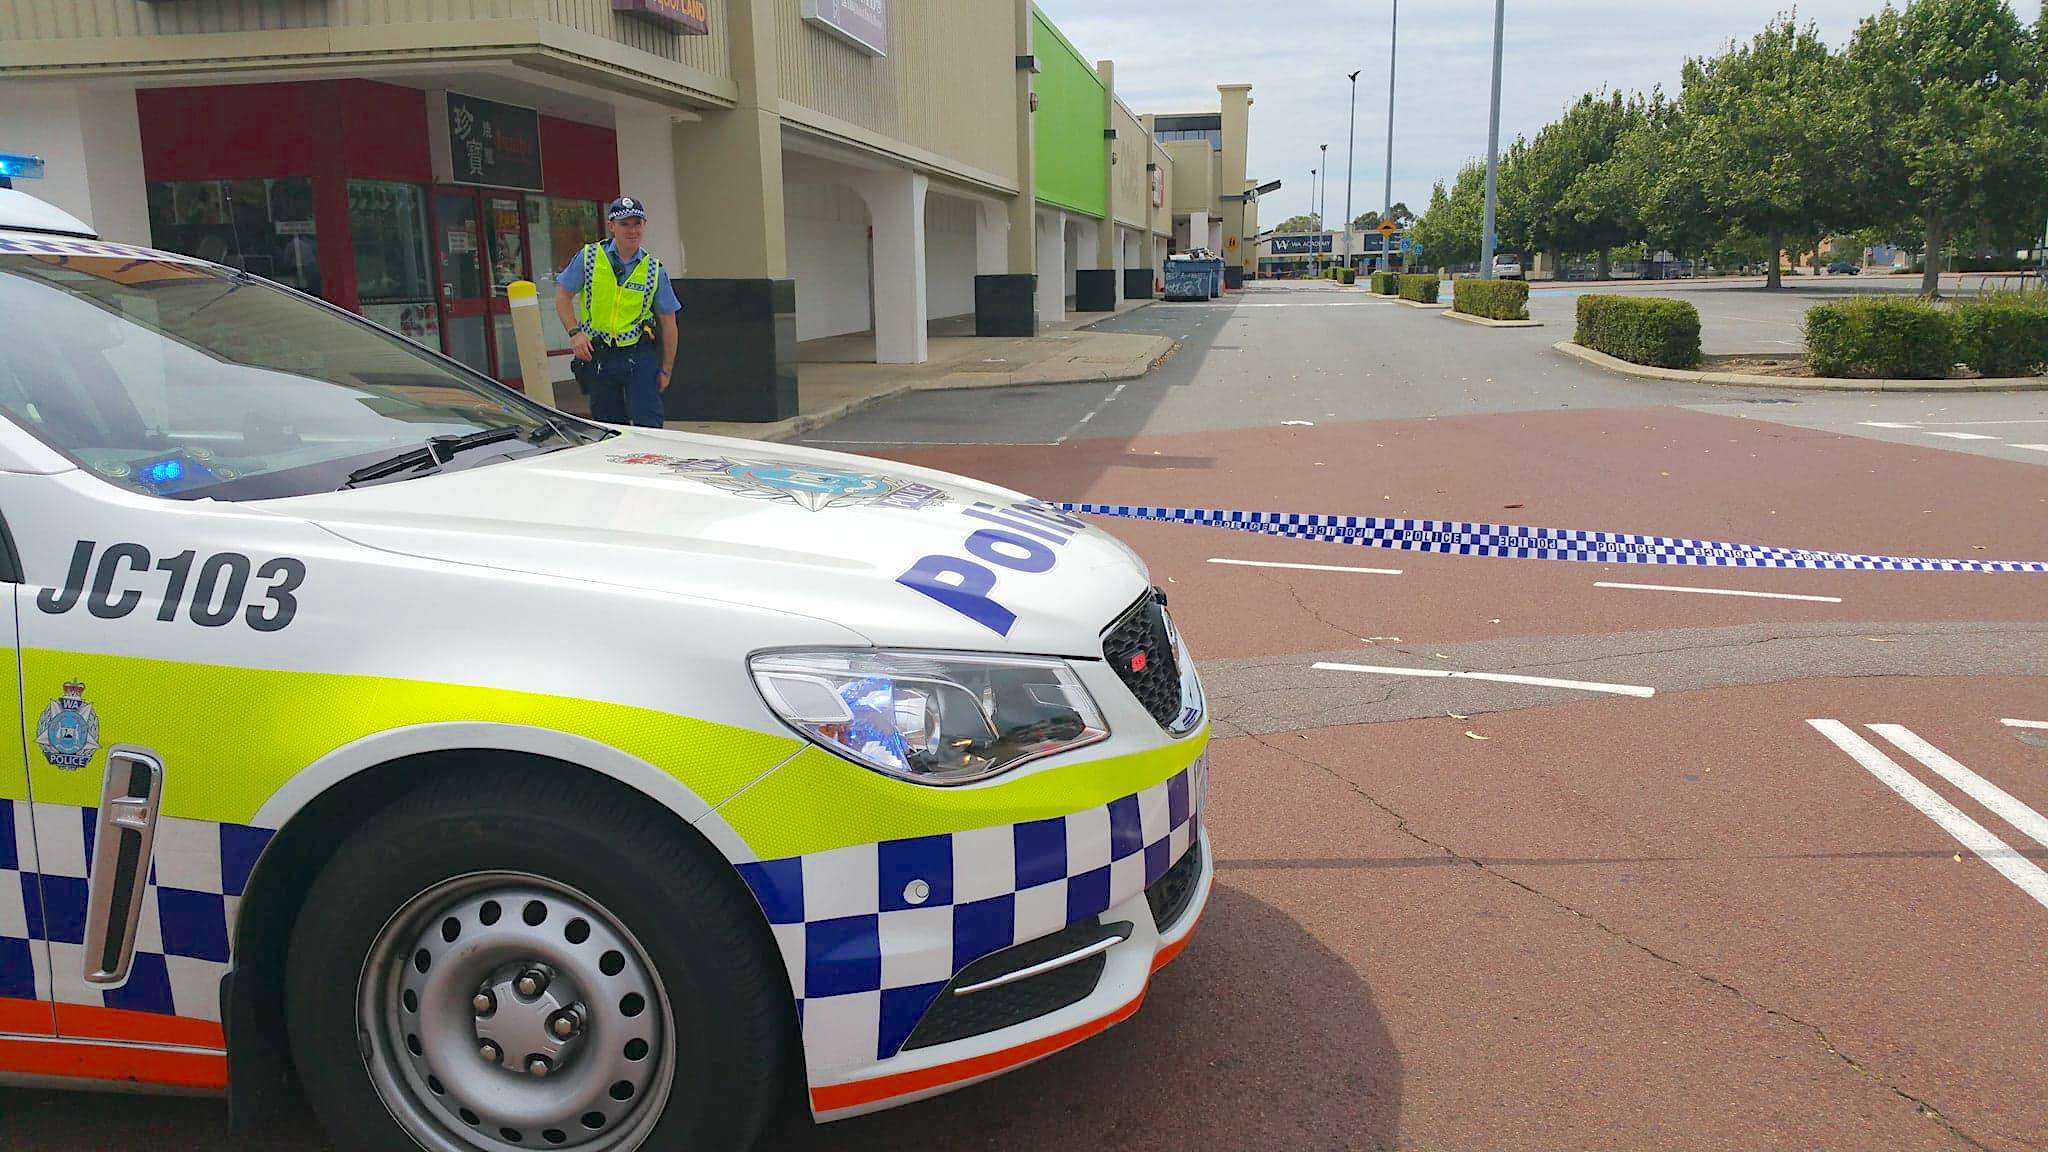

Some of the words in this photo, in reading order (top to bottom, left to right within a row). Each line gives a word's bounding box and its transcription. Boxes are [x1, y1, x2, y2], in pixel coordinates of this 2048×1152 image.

[1212, 520, 1270, 531] POLICE
[1404, 532, 1461, 544] POLICE
[1500, 537, 1557, 549] POLICE
[1598, 542, 1656, 554] POLICE
[36, 540, 307, 633] JC103
[63, 699, 80, 710] WA
[50, 754, 85, 767] POLICE
